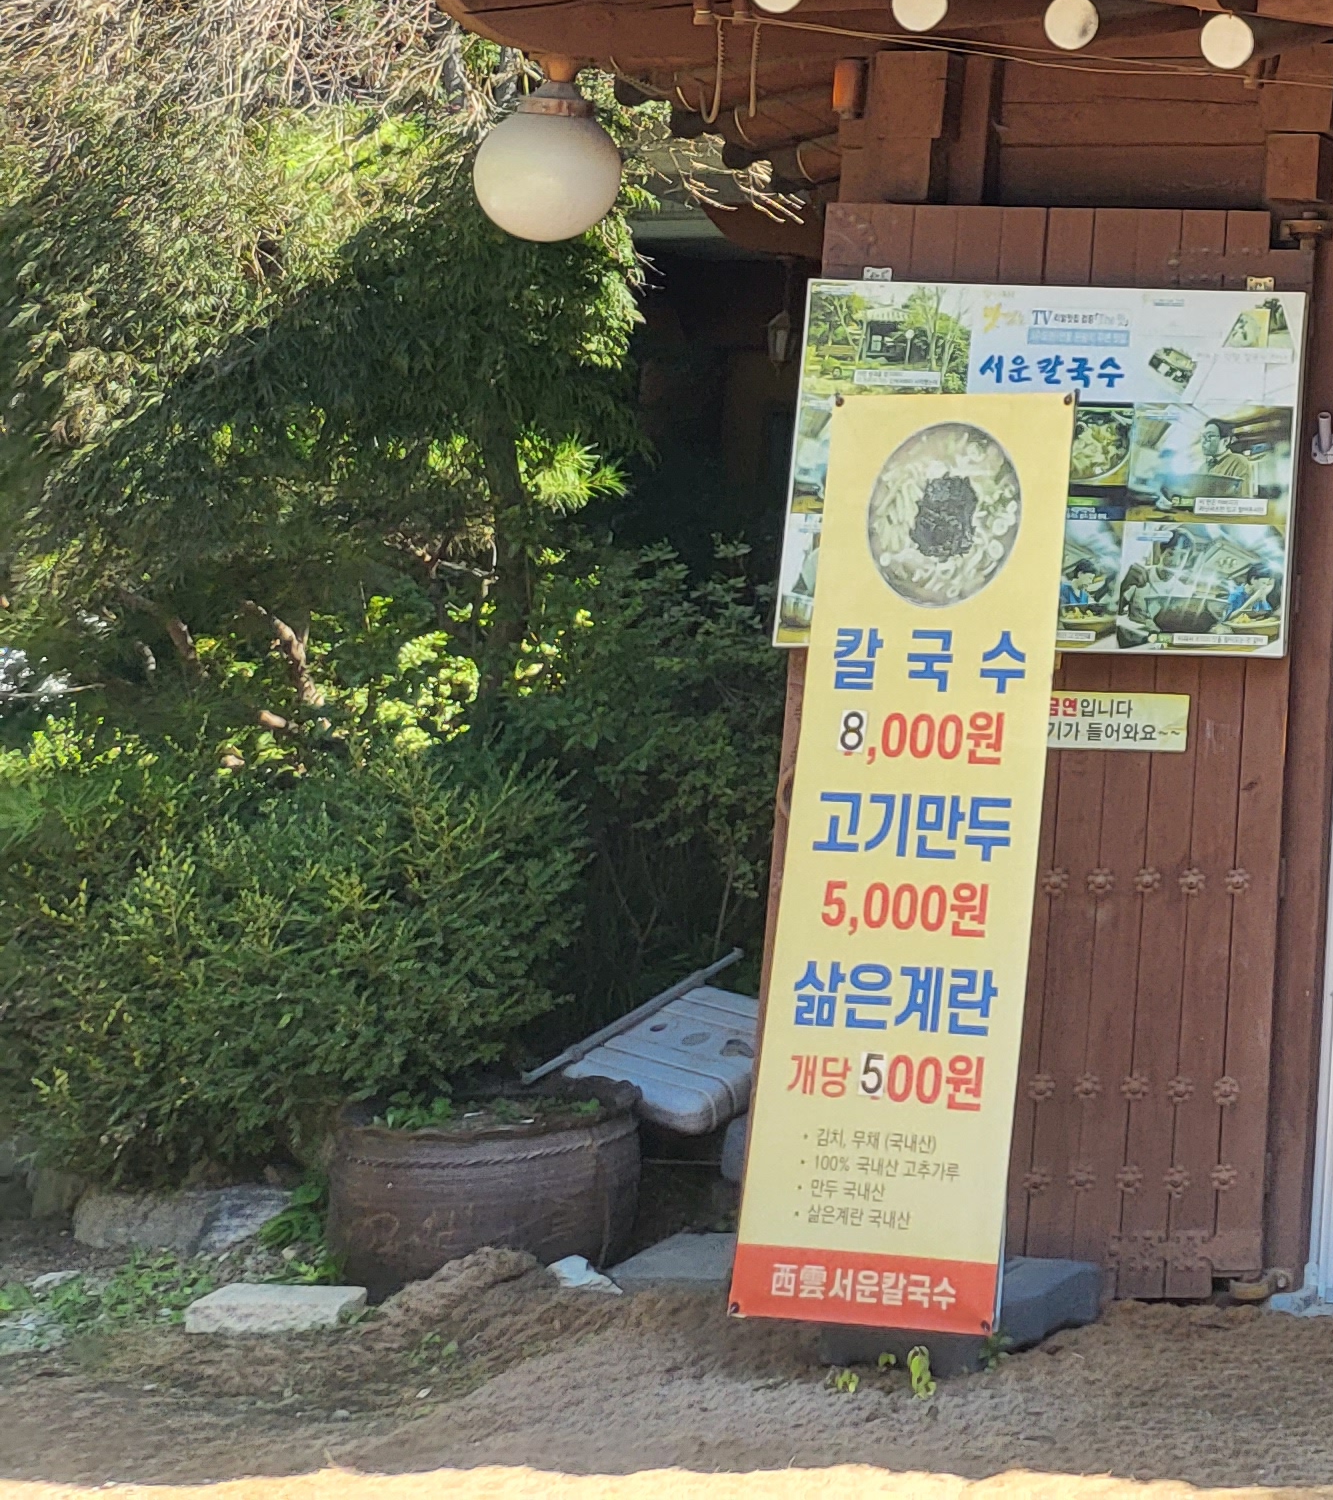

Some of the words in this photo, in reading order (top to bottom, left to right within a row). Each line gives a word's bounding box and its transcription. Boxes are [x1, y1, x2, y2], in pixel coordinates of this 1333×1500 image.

[1032, 310, 1053, 325] TV
[979, 355, 1125, 388] 서운칼국수
[833, 627, 1027, 694] 칼국수
[837, 710, 1005, 766] 8,000원
[812, 791, 1013, 862] 고기만두
[821, 881, 989, 938] 5,000원
[793, 961, 998, 1036] 삶은계란
[787, 1054, 852, 1097] 개당
[860, 1052, 985, 1111] 500원
[852, 1130, 881, 1150] 무채
[884, 1133, 937, 1155] (국내산)
[811, 1178, 839, 1199] 만두
[843, 1181, 886, 1202] 국내산
[814, 1155, 850, 1172] 100%
[856, 1156, 899, 1178] 국내산
[903, 1160, 961, 1182] 고추가루
[807, 1204, 864, 1227] 삶은계란
[868, 1209, 911, 1231] 국내산
[829, 1266, 957, 1311] 서운칼국수
